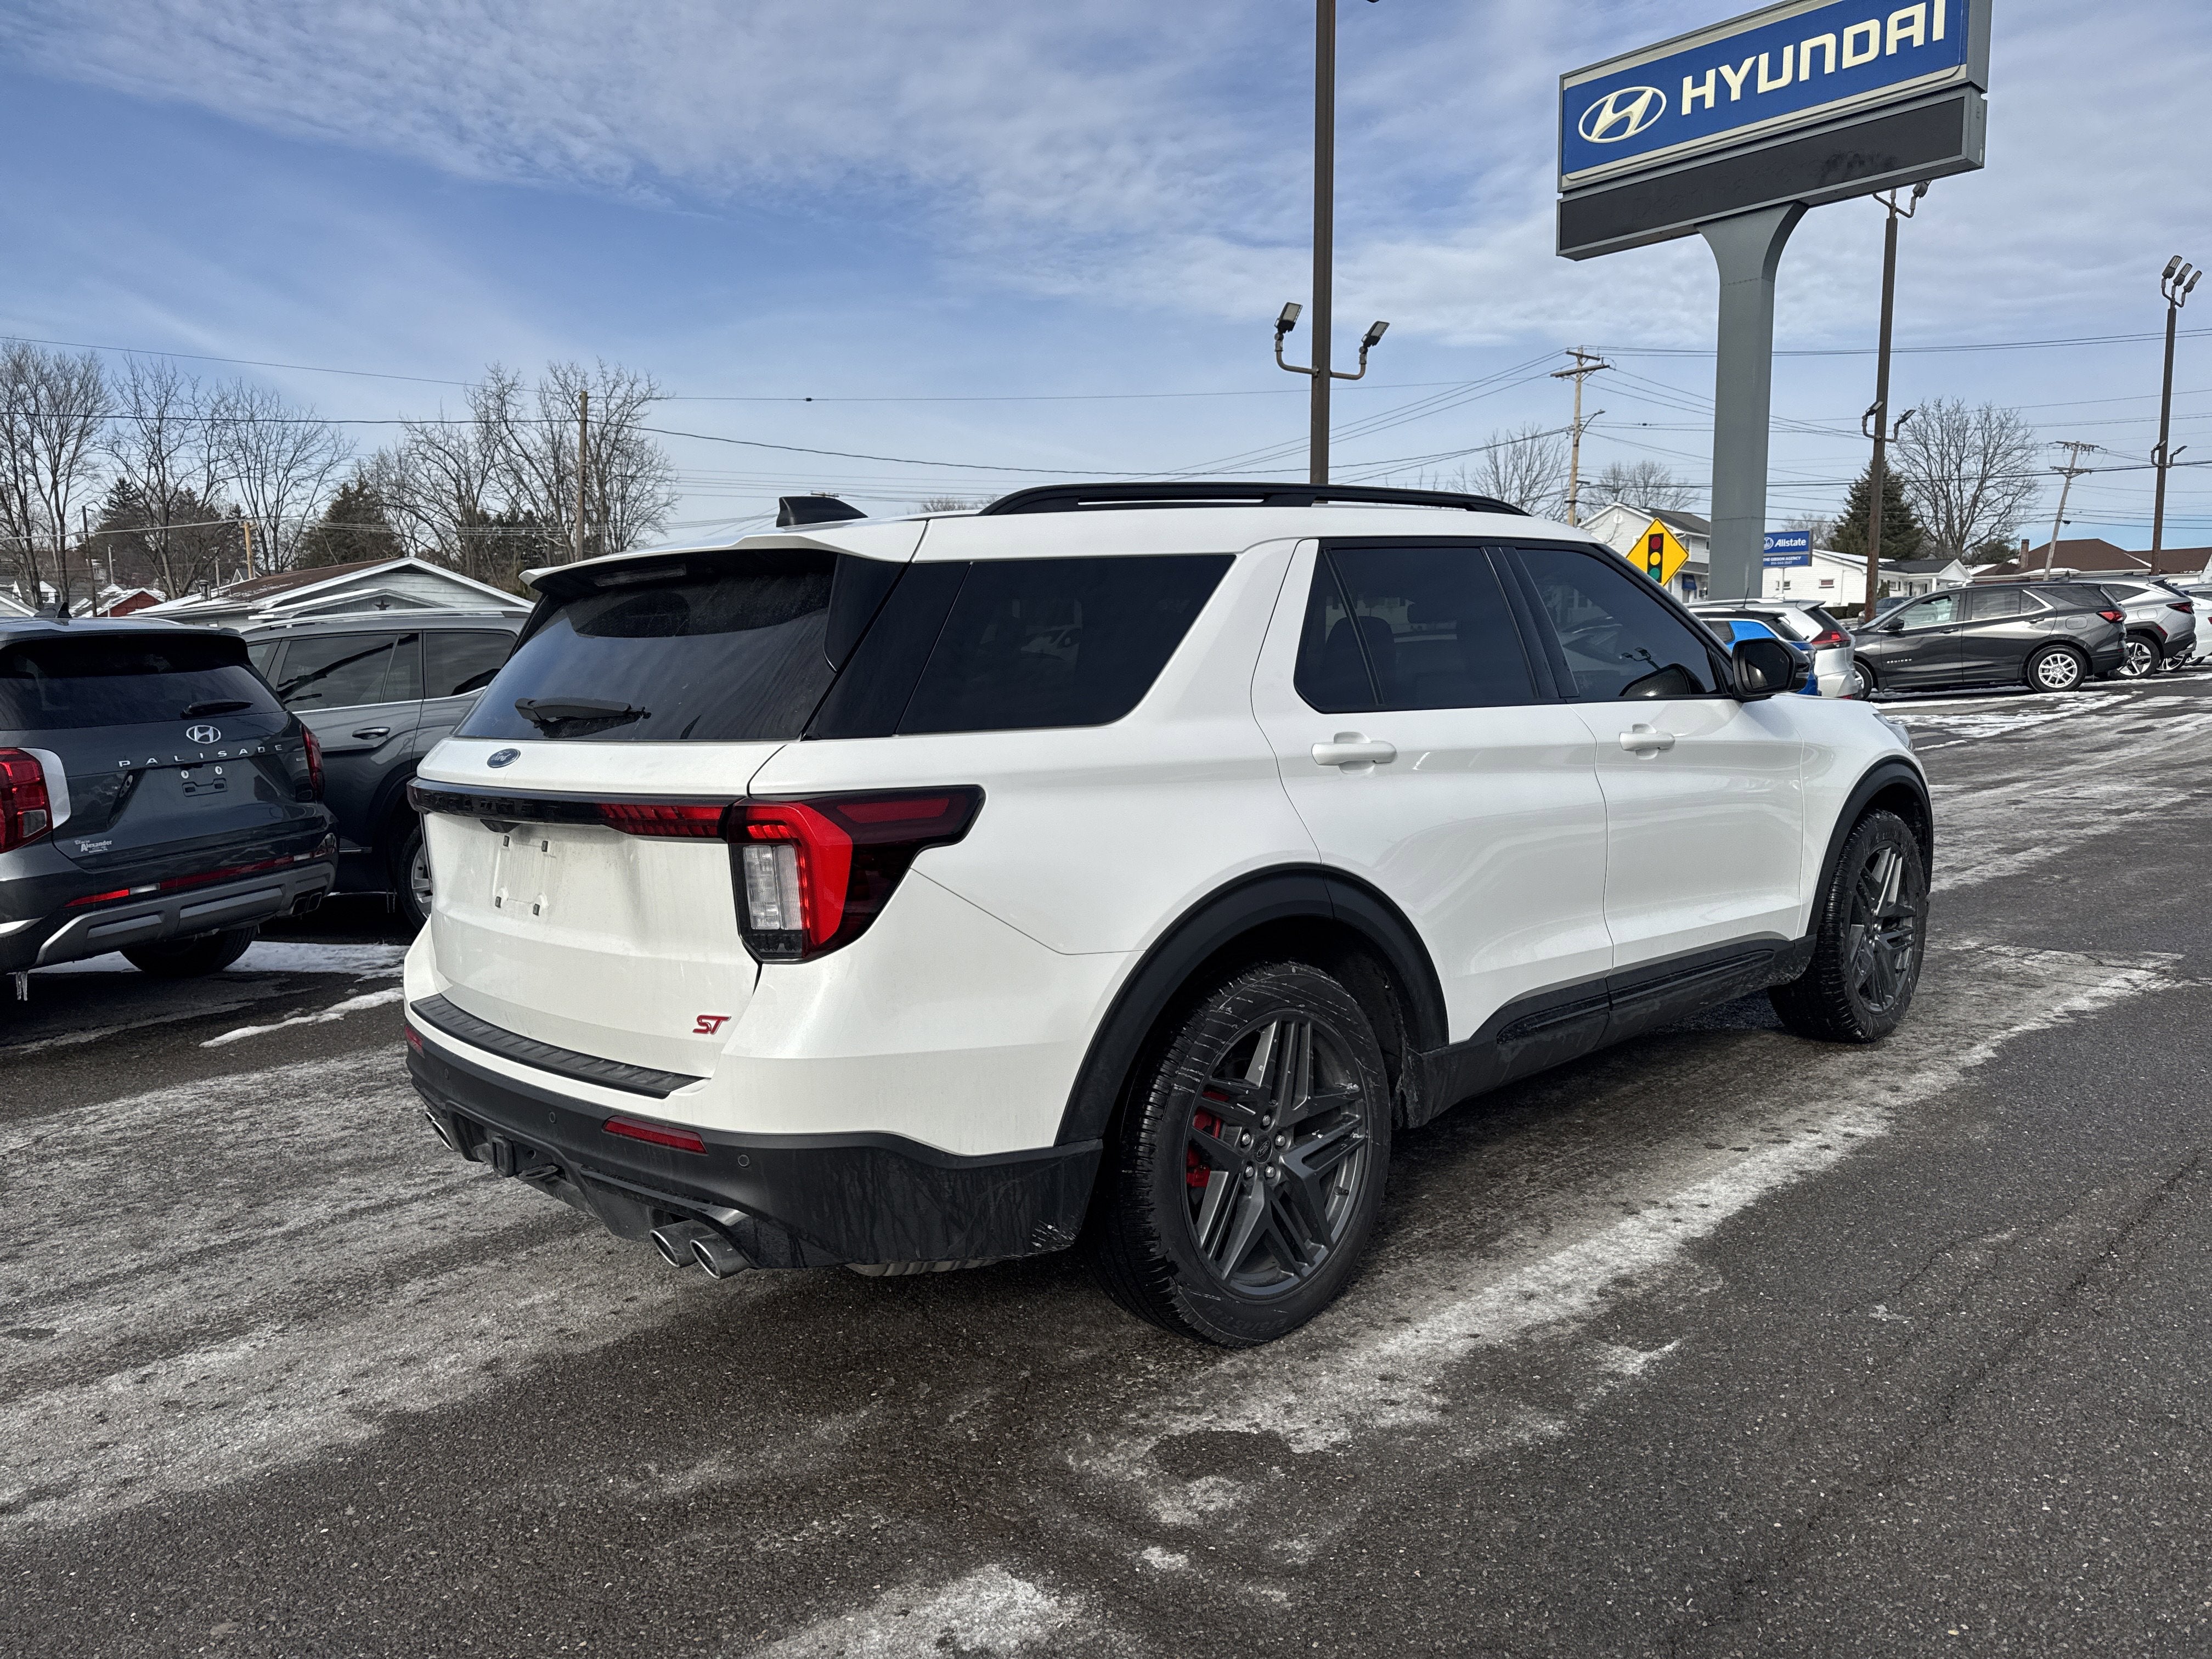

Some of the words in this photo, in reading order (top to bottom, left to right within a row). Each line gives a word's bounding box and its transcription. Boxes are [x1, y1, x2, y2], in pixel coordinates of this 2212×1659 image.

[1681, 0, 1945, 116] HYUNDAI
[1774, 538, 1807, 548] Allstate
[119, 744, 283, 768] PALISADE
[81, 840, 112, 852] Alexander
[692, 1015, 732, 1035] ST
